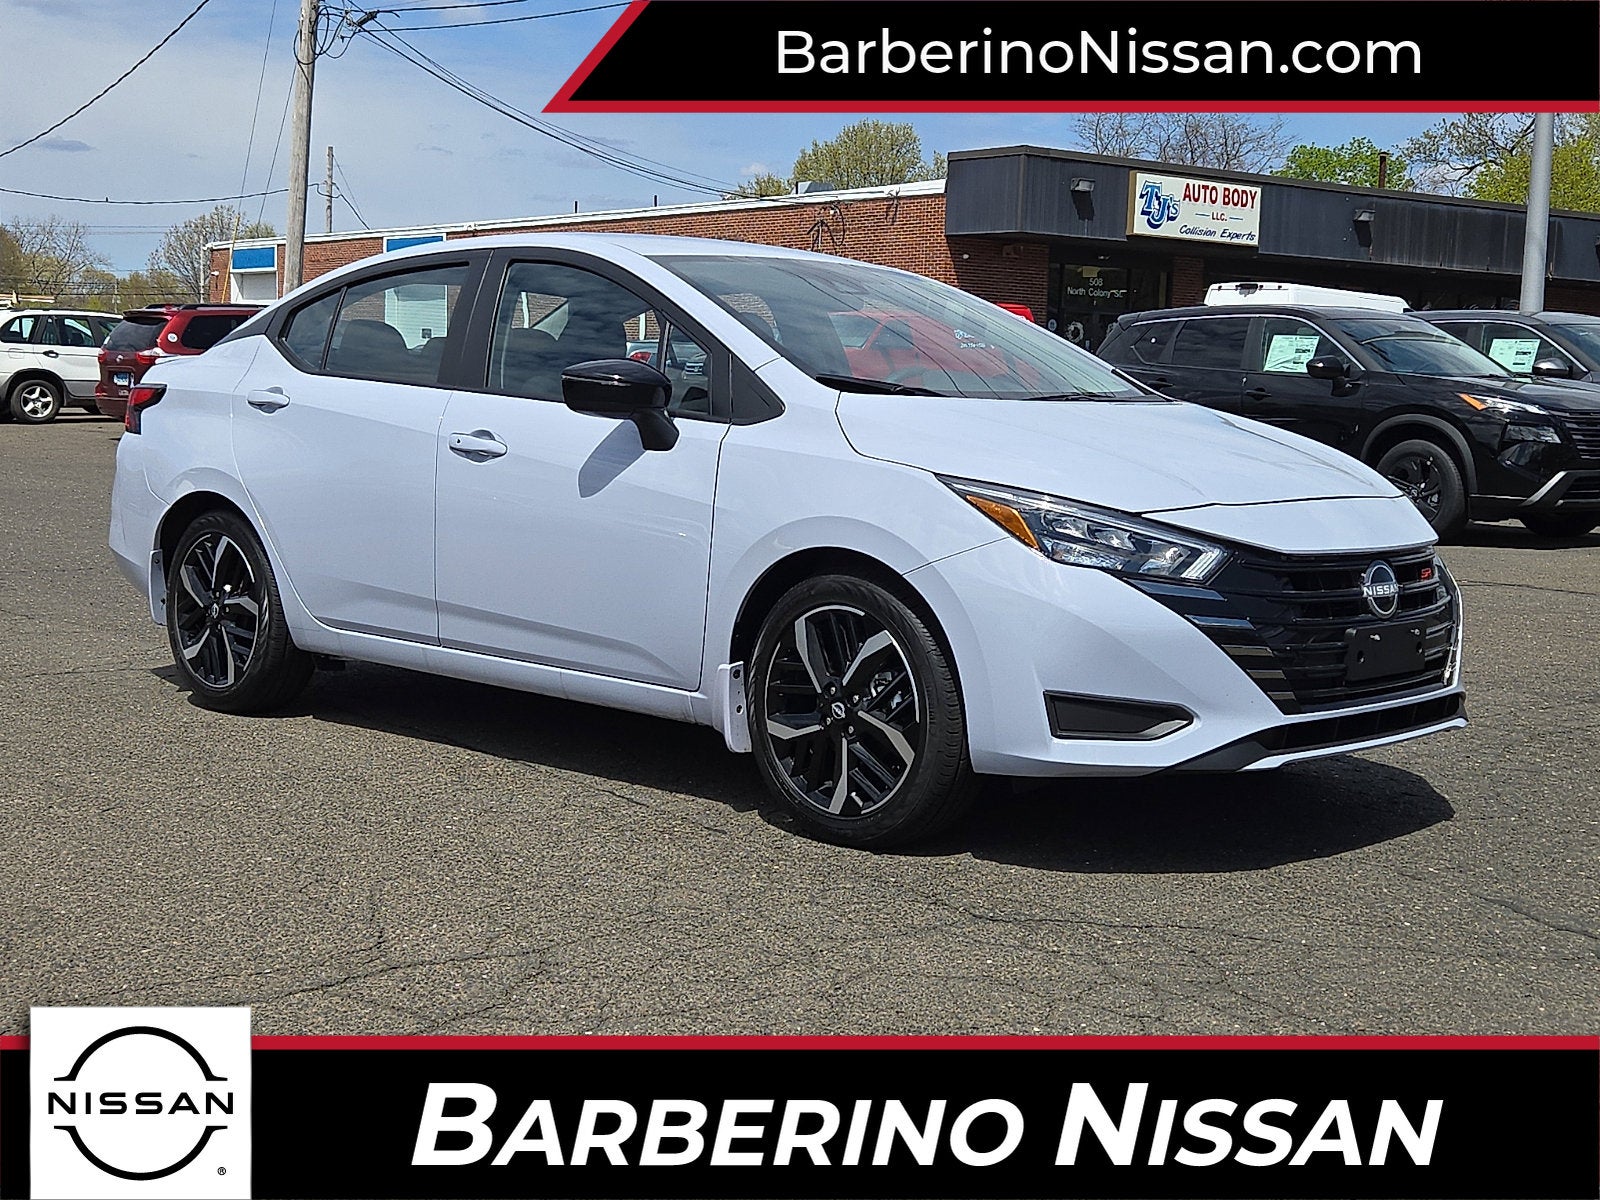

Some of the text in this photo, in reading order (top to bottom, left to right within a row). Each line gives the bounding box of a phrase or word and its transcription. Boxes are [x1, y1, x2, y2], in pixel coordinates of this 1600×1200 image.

[1182, 182, 1257, 209] AUTO BODY
[1180, 224, 1256, 241] Collision Experts
[1067, 286, 1086, 296] North
[1088, 288, 1111, 298] Colony
[1363, 584, 1399, 596] NISSAN
